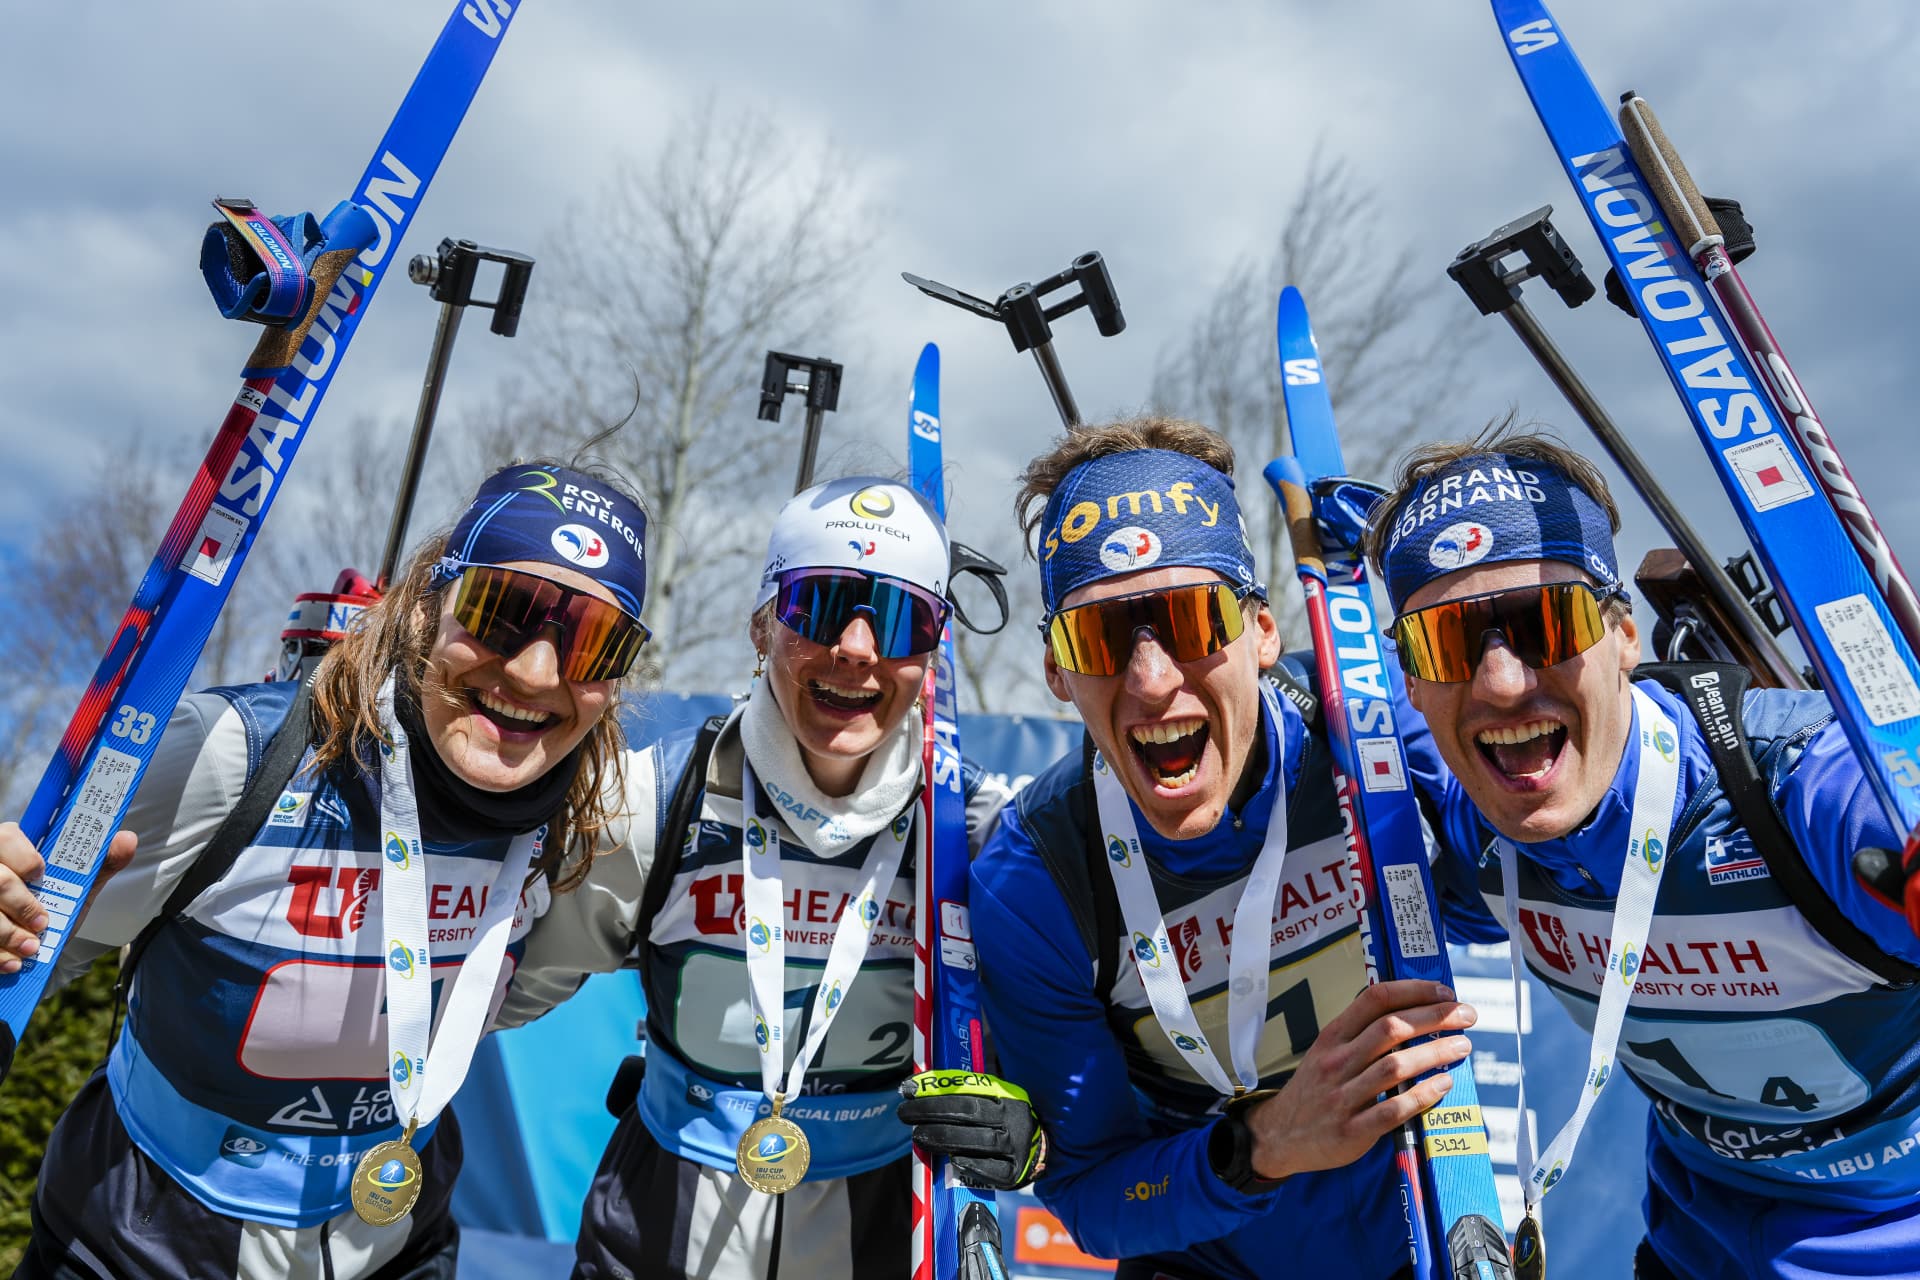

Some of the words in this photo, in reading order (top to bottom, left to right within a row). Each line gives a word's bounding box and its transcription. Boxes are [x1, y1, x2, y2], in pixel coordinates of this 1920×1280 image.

[249, 221, 293, 270] SALOMON
[1570, 147, 1772, 439] SALOMON
[219, 149, 422, 517] SALOMON
[563, 484, 615, 510] ROY
[1394, 498, 1419, 529] LE
[1422, 467, 1540, 504] GRAND
[1045, 481, 1219, 561] somfy
[1390, 485, 1547, 553] BORNAND
[562, 498, 644, 560] ENERGIE
[825, 520, 911, 542] PROLUTECH
[1703, 686, 1726, 715] Jean
[111, 704, 156, 745] 33
[1714, 714, 1739, 750] Lain
[766, 781, 834, 830] CRAFT
[411, 839, 420, 856] IBU
[1130, 838, 1140, 854] IBU
[1630, 839, 1639, 856] IBU
[1711, 865, 1768, 883] BIATHLON
[1322, 905, 1345, 921] OF
[889, 935, 915, 946] UTA
[1159, 937, 1169, 953] IBU
[419, 948, 427, 965] IBU
[1610, 953, 1618, 970] IBU
[819, 983, 828, 998] IBU
[1691, 983, 1716, 998] OF
[1724, 981, 1780, 997] UTAH
[862, 1021, 910, 1066] 2
[416, 1058, 424, 1074] IBU
[1588, 1068, 1597, 1086] IBU
[353, 1086, 390, 1104] La
[1760, 1076, 1820, 1112] 4
[725, 1097, 755, 1114] THE
[834, 1109, 860, 1122] IBU
[860, 1104, 887, 1120] APP
[1427, 1109, 1472, 1127] GAETAN
[281, 1151, 316, 1167] THE
[1828, 1152, 1875, 1178] IBU
[754, 1173, 787, 1181] BIATHLON
[1533, 1168, 1545, 1184] IBU
[369, 1191, 380, 1201] IBU
[380, 1194, 393, 1205] CUP
